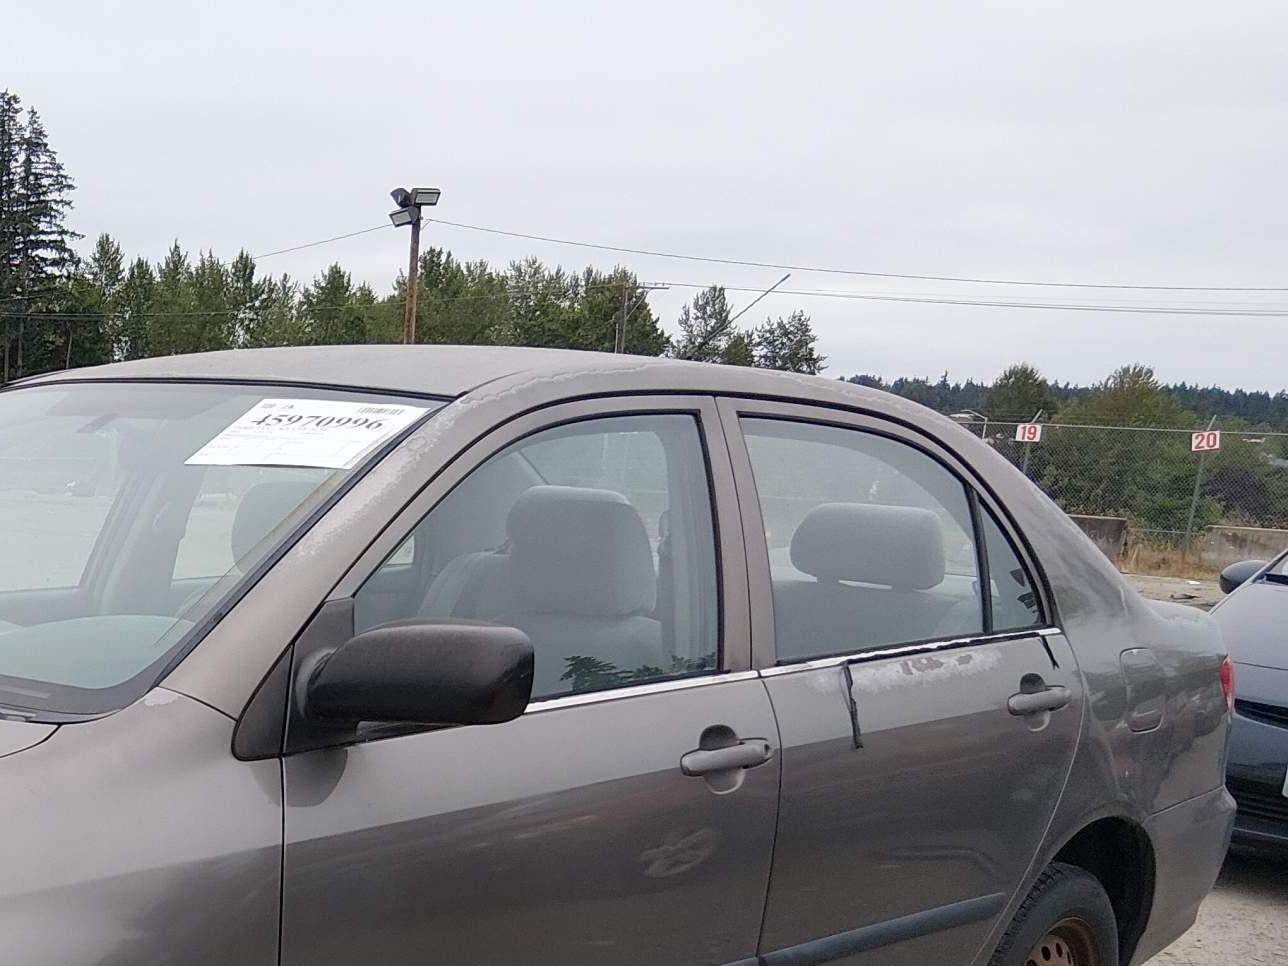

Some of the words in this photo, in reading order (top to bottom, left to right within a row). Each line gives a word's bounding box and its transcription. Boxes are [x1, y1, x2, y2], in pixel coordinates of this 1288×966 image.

[251, 414, 389, 430] 45970996
[1021, 425, 1037, 440] 19
[1194, 432, 1217, 449] 20
